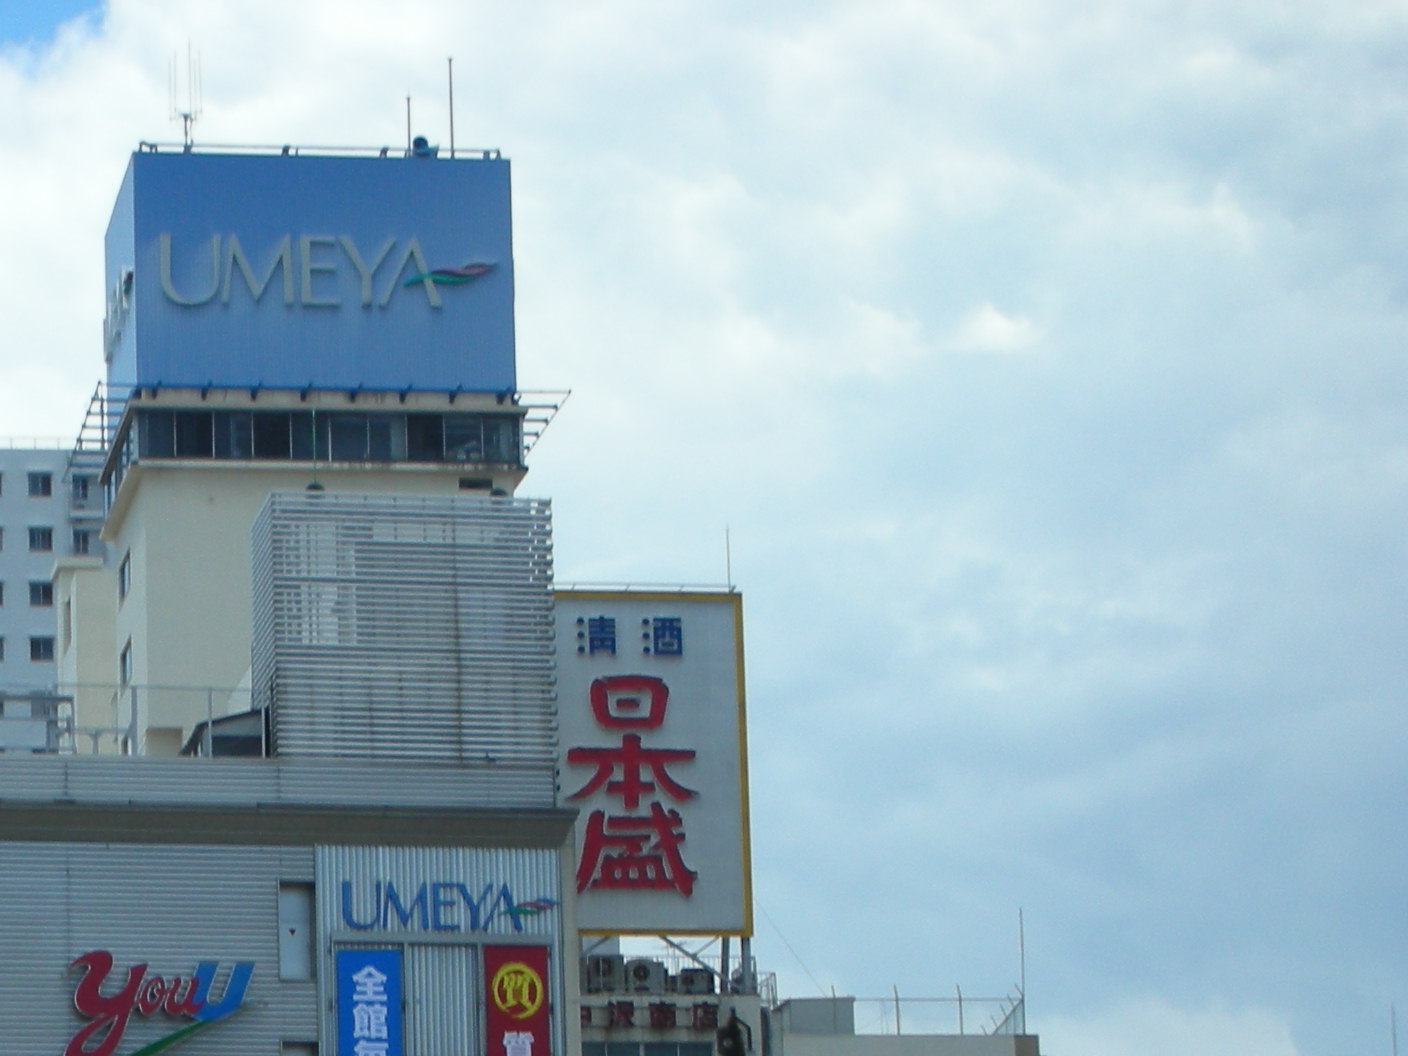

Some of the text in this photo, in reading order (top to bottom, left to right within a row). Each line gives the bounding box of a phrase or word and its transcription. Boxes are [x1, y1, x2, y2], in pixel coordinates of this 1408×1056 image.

[159, 232, 443, 310] UMEYA
[576, 615, 684, 656] 清酒
[565, 674, 700, 898] 日本盛
[341, 881, 523, 932] UMEYA
